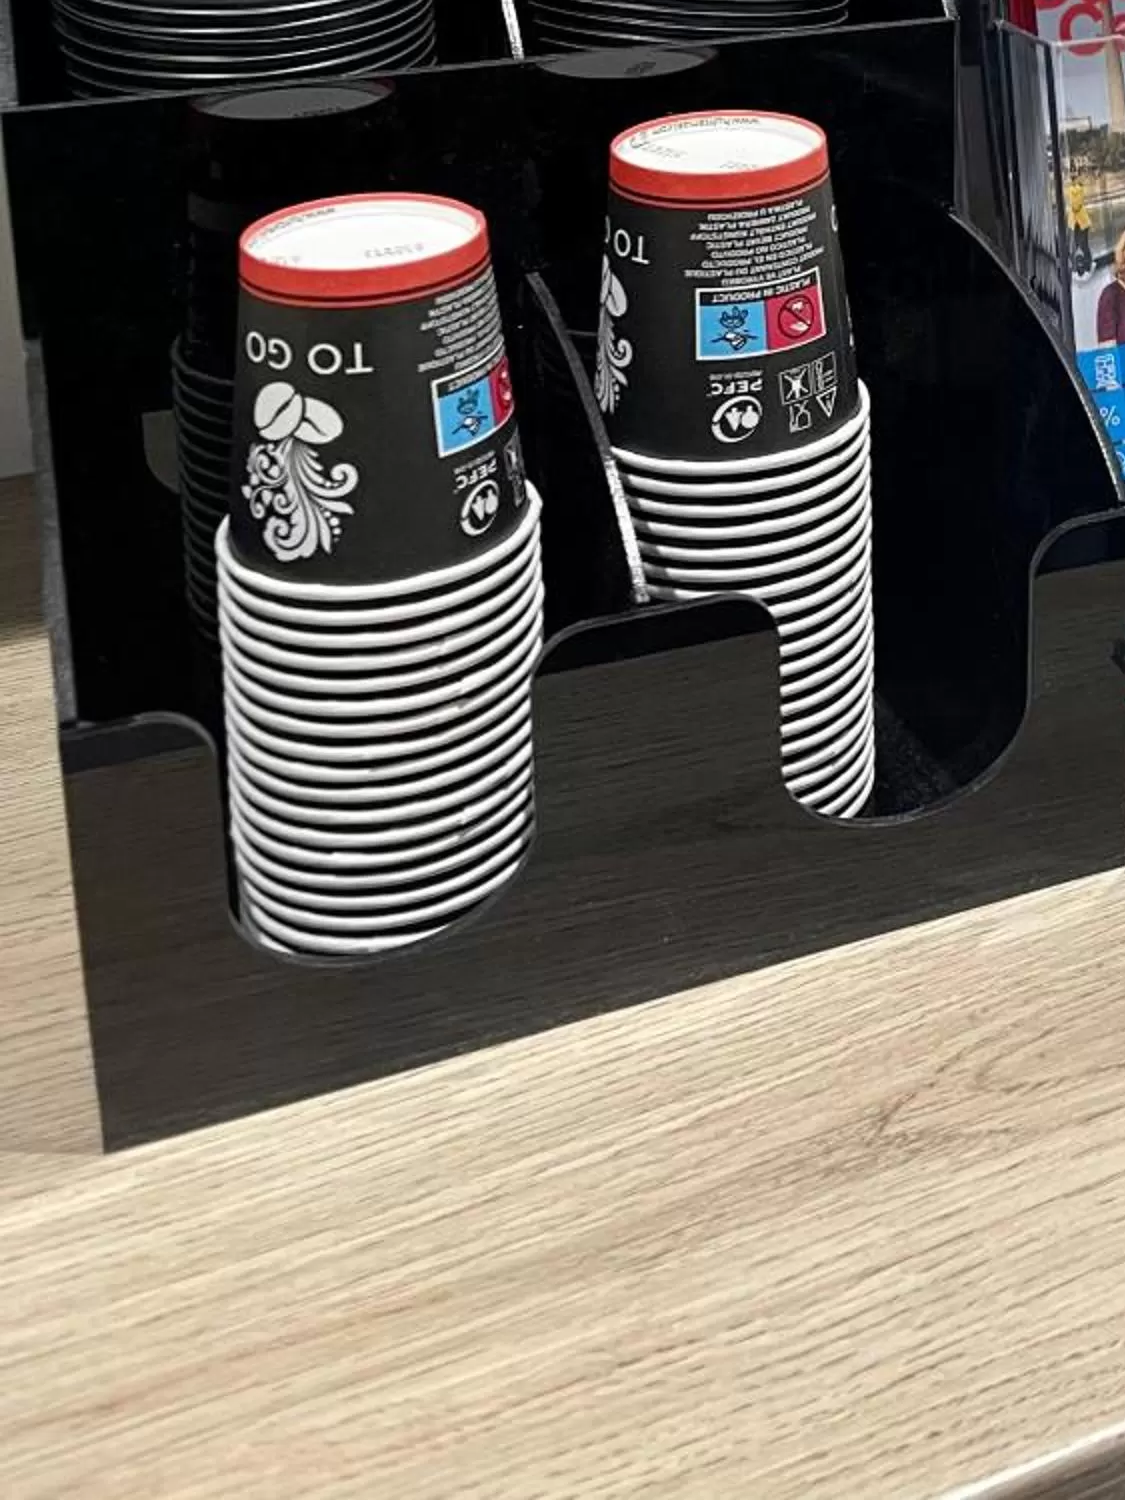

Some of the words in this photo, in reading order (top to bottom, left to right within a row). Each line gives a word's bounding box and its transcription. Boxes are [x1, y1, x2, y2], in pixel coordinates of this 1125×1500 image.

[612, 229, 650, 264] TO
[245, 330, 293, 369] GO
[306, 342, 374, 375] TO
[709, 376, 764, 397] PEFC
